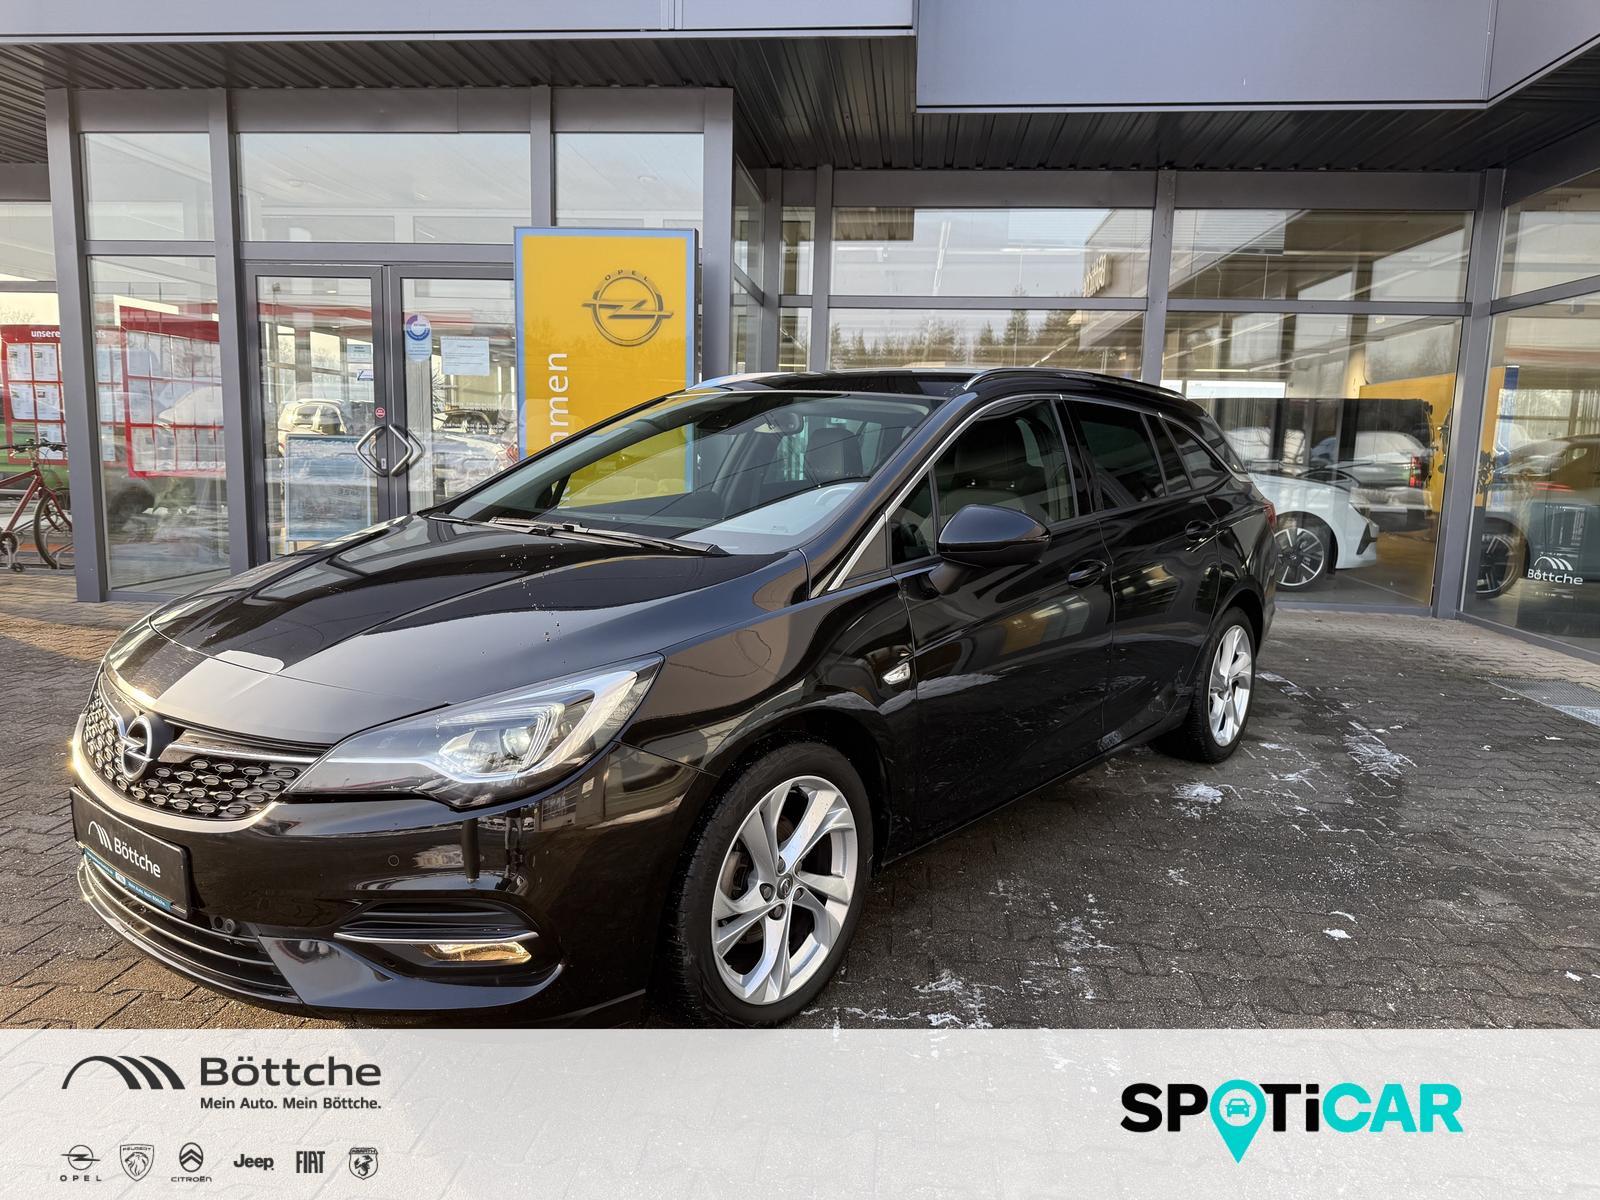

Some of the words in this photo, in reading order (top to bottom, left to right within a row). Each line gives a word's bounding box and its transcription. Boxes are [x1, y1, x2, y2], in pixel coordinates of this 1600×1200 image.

[604, 269, 648, 282] OPEL
[31, 330, 61, 338] unsere
[1528, 568, 1584, 585] Böttche
[114, 837, 161, 877] Böttche
